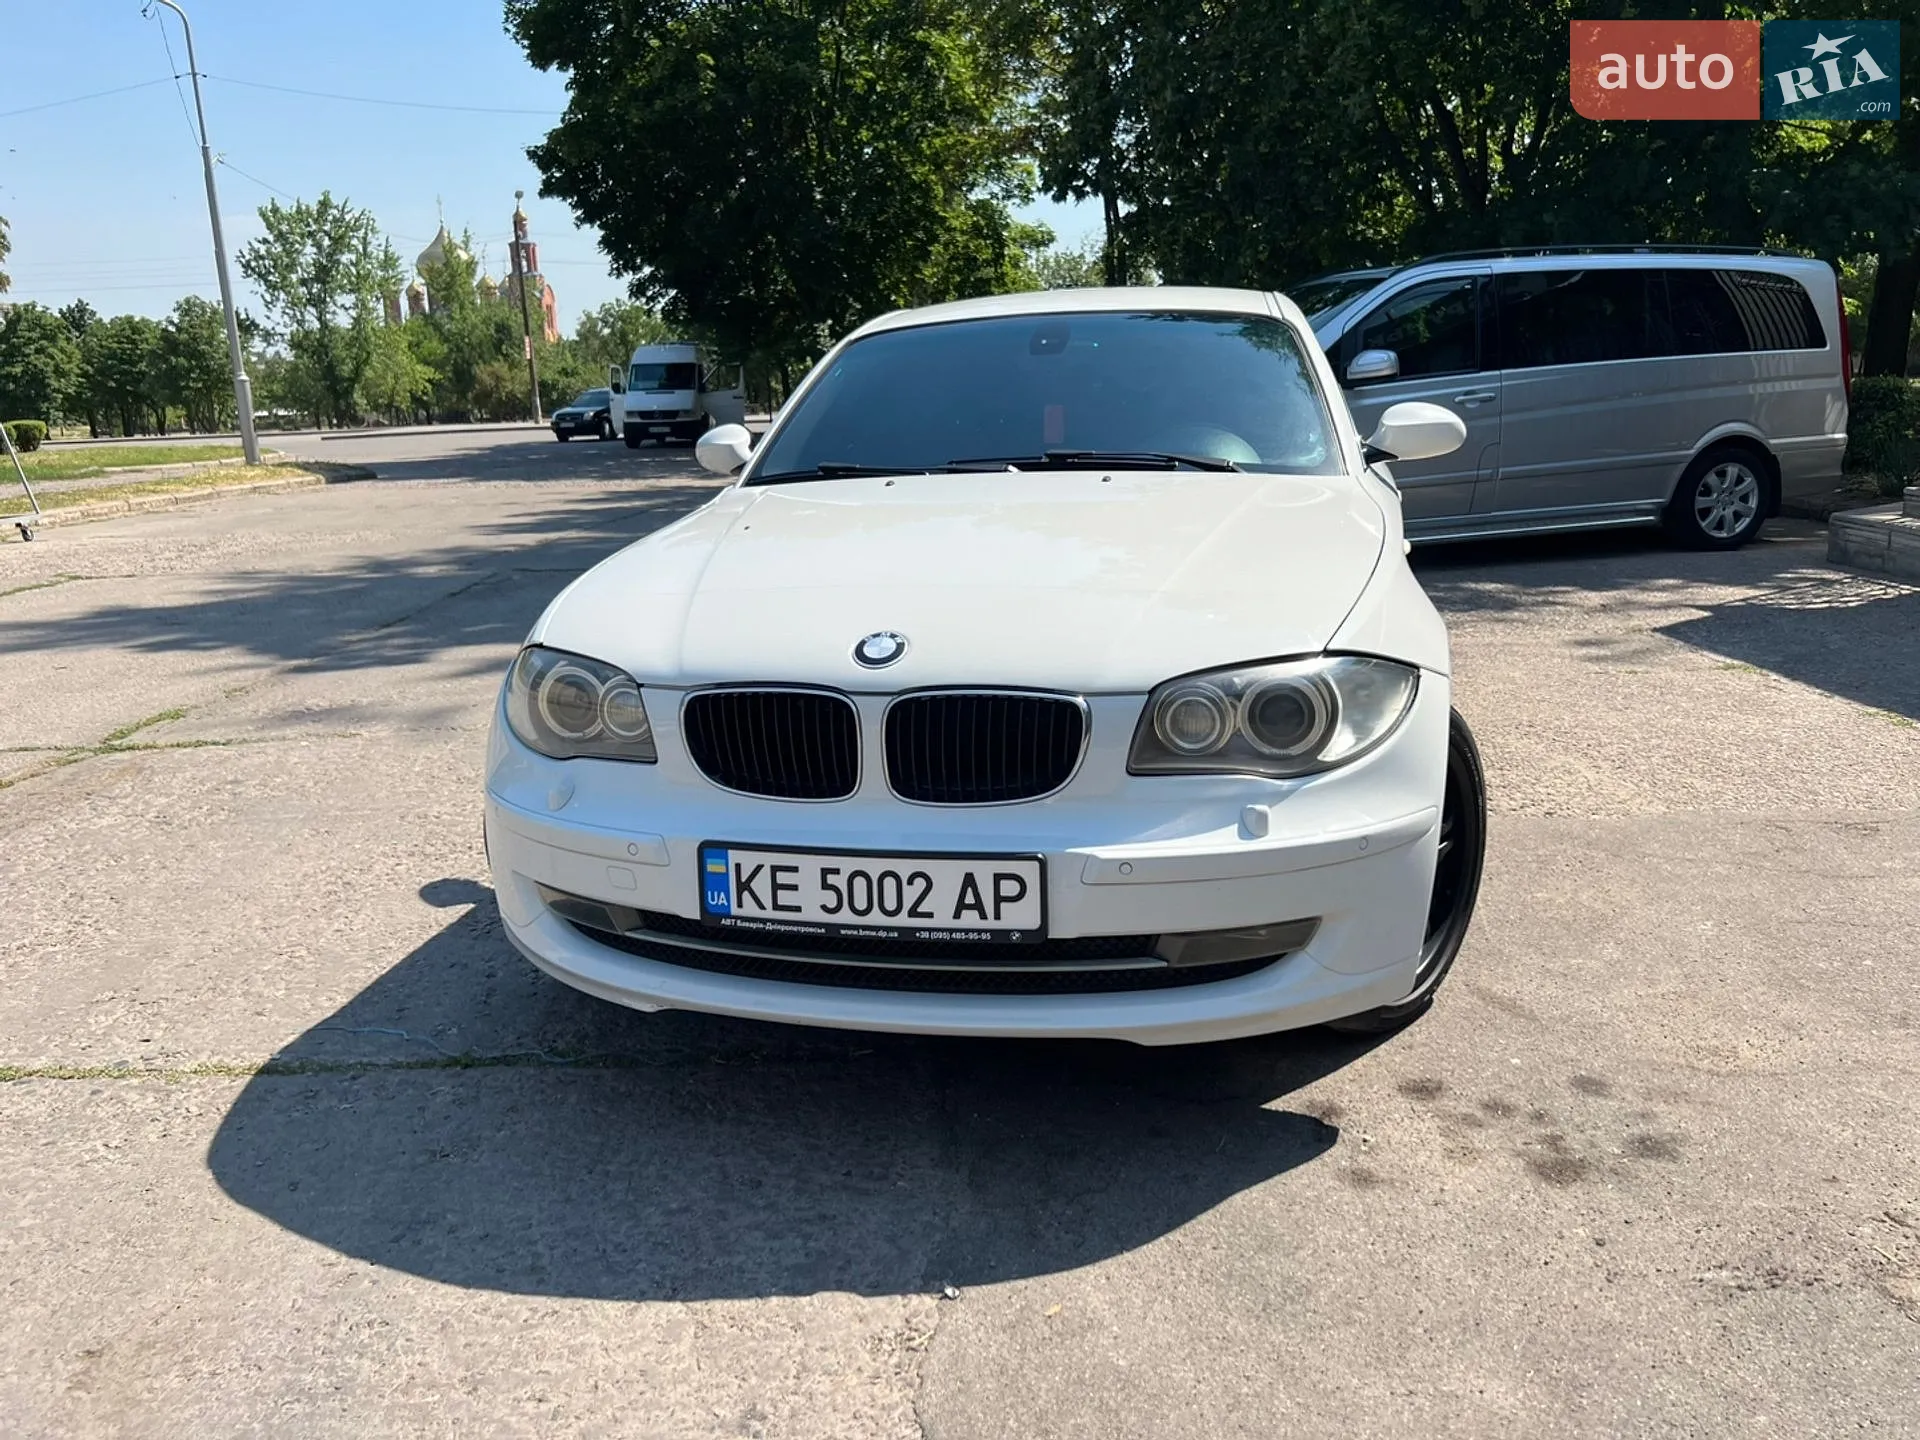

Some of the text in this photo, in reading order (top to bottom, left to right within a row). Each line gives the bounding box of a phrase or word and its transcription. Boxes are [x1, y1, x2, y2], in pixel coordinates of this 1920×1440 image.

[707, 890, 728, 907] UA
[734, 862, 1028, 921] KE 5002 AP
